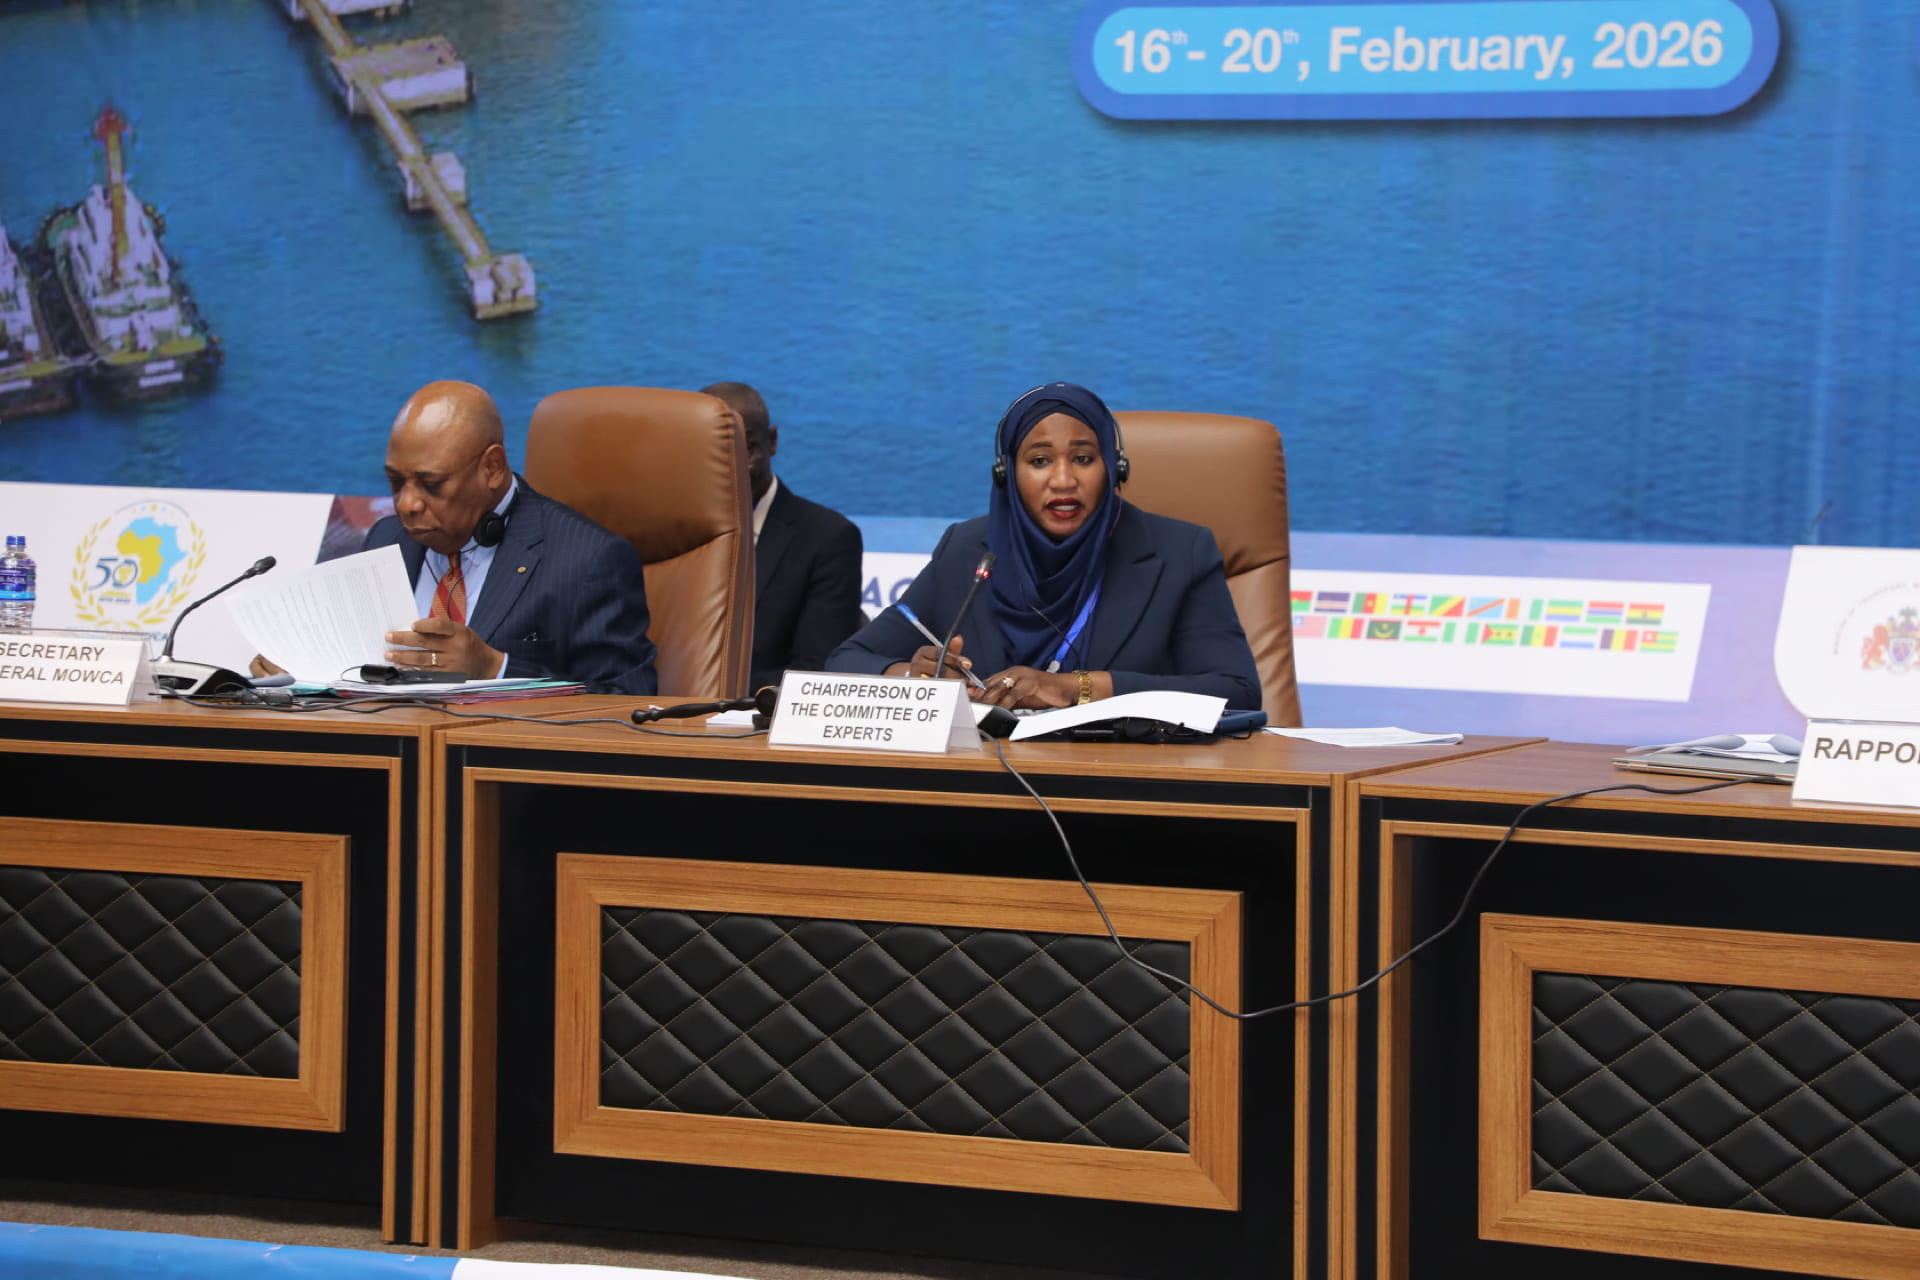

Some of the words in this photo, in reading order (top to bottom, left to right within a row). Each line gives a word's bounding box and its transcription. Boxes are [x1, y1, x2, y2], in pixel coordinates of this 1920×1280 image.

[1221, 27, 1310, 81] 20th,
[1328, 26, 1574, 80] February,
[1592, 19, 1723, 68] 2026
[87, 557, 139, 590] 50
[0, 641, 104, 662] SECRETARY
[52, 668, 124, 685] MOWCA
[801, 681, 911, 700] CHAIRPERSON
[915, 687, 937, 701] OF
[790, 702, 820, 717] THE
[823, 703, 913, 721] COMMITTEE
[917, 708, 939, 722] OF
[823, 725, 893, 742] EXPERTS
[1813, 736, 1920, 764] RAPPO
